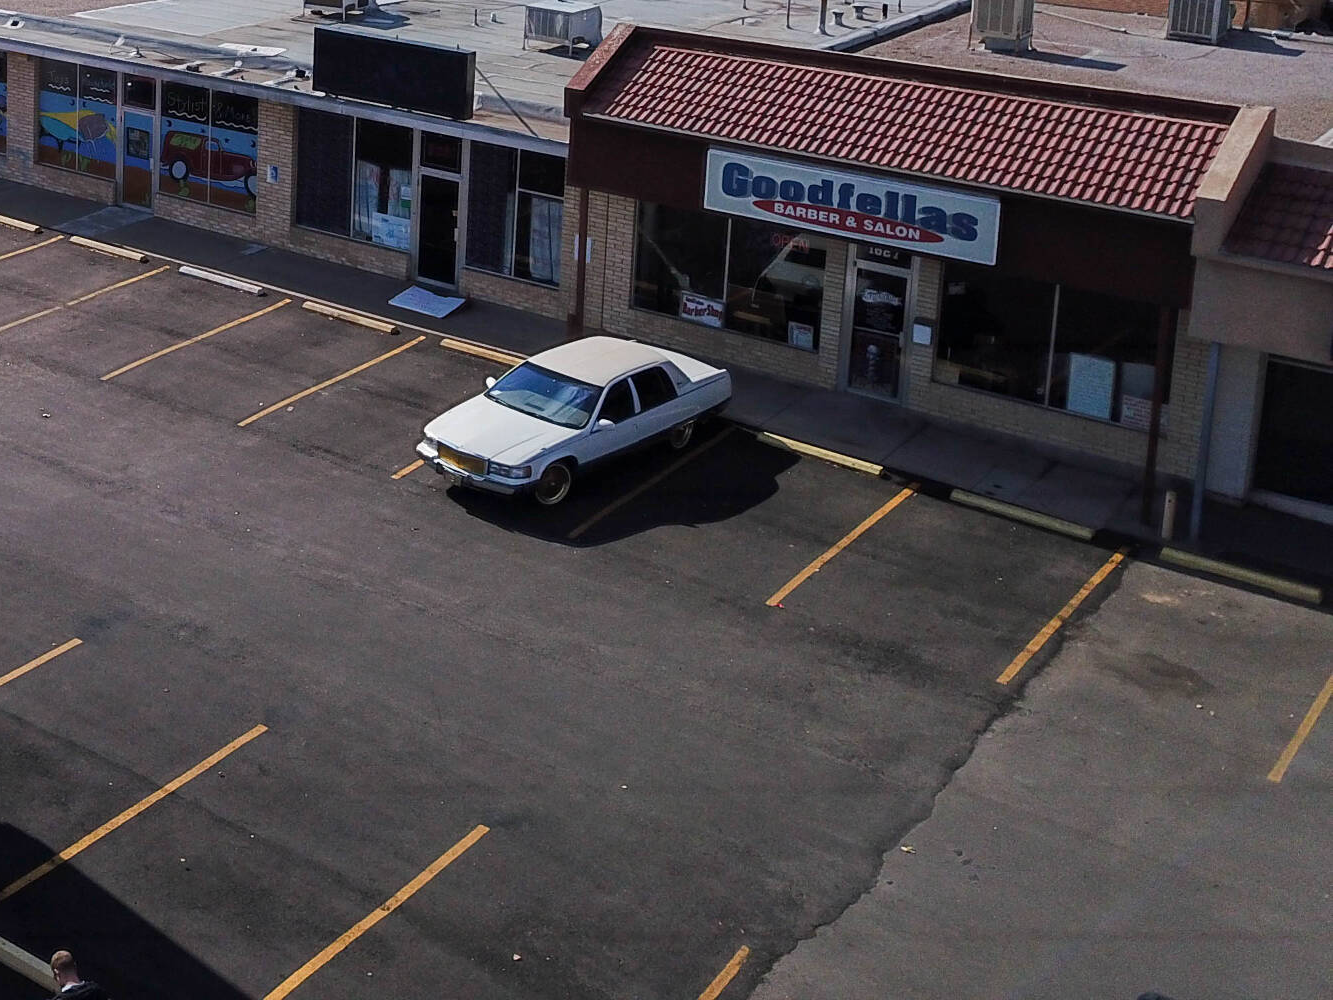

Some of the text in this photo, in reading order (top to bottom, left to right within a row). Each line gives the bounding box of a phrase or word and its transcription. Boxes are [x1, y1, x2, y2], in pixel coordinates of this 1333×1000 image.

[721, 161, 979, 242] Goodfellas
[773, 202, 921, 241] BARBER & SALON
